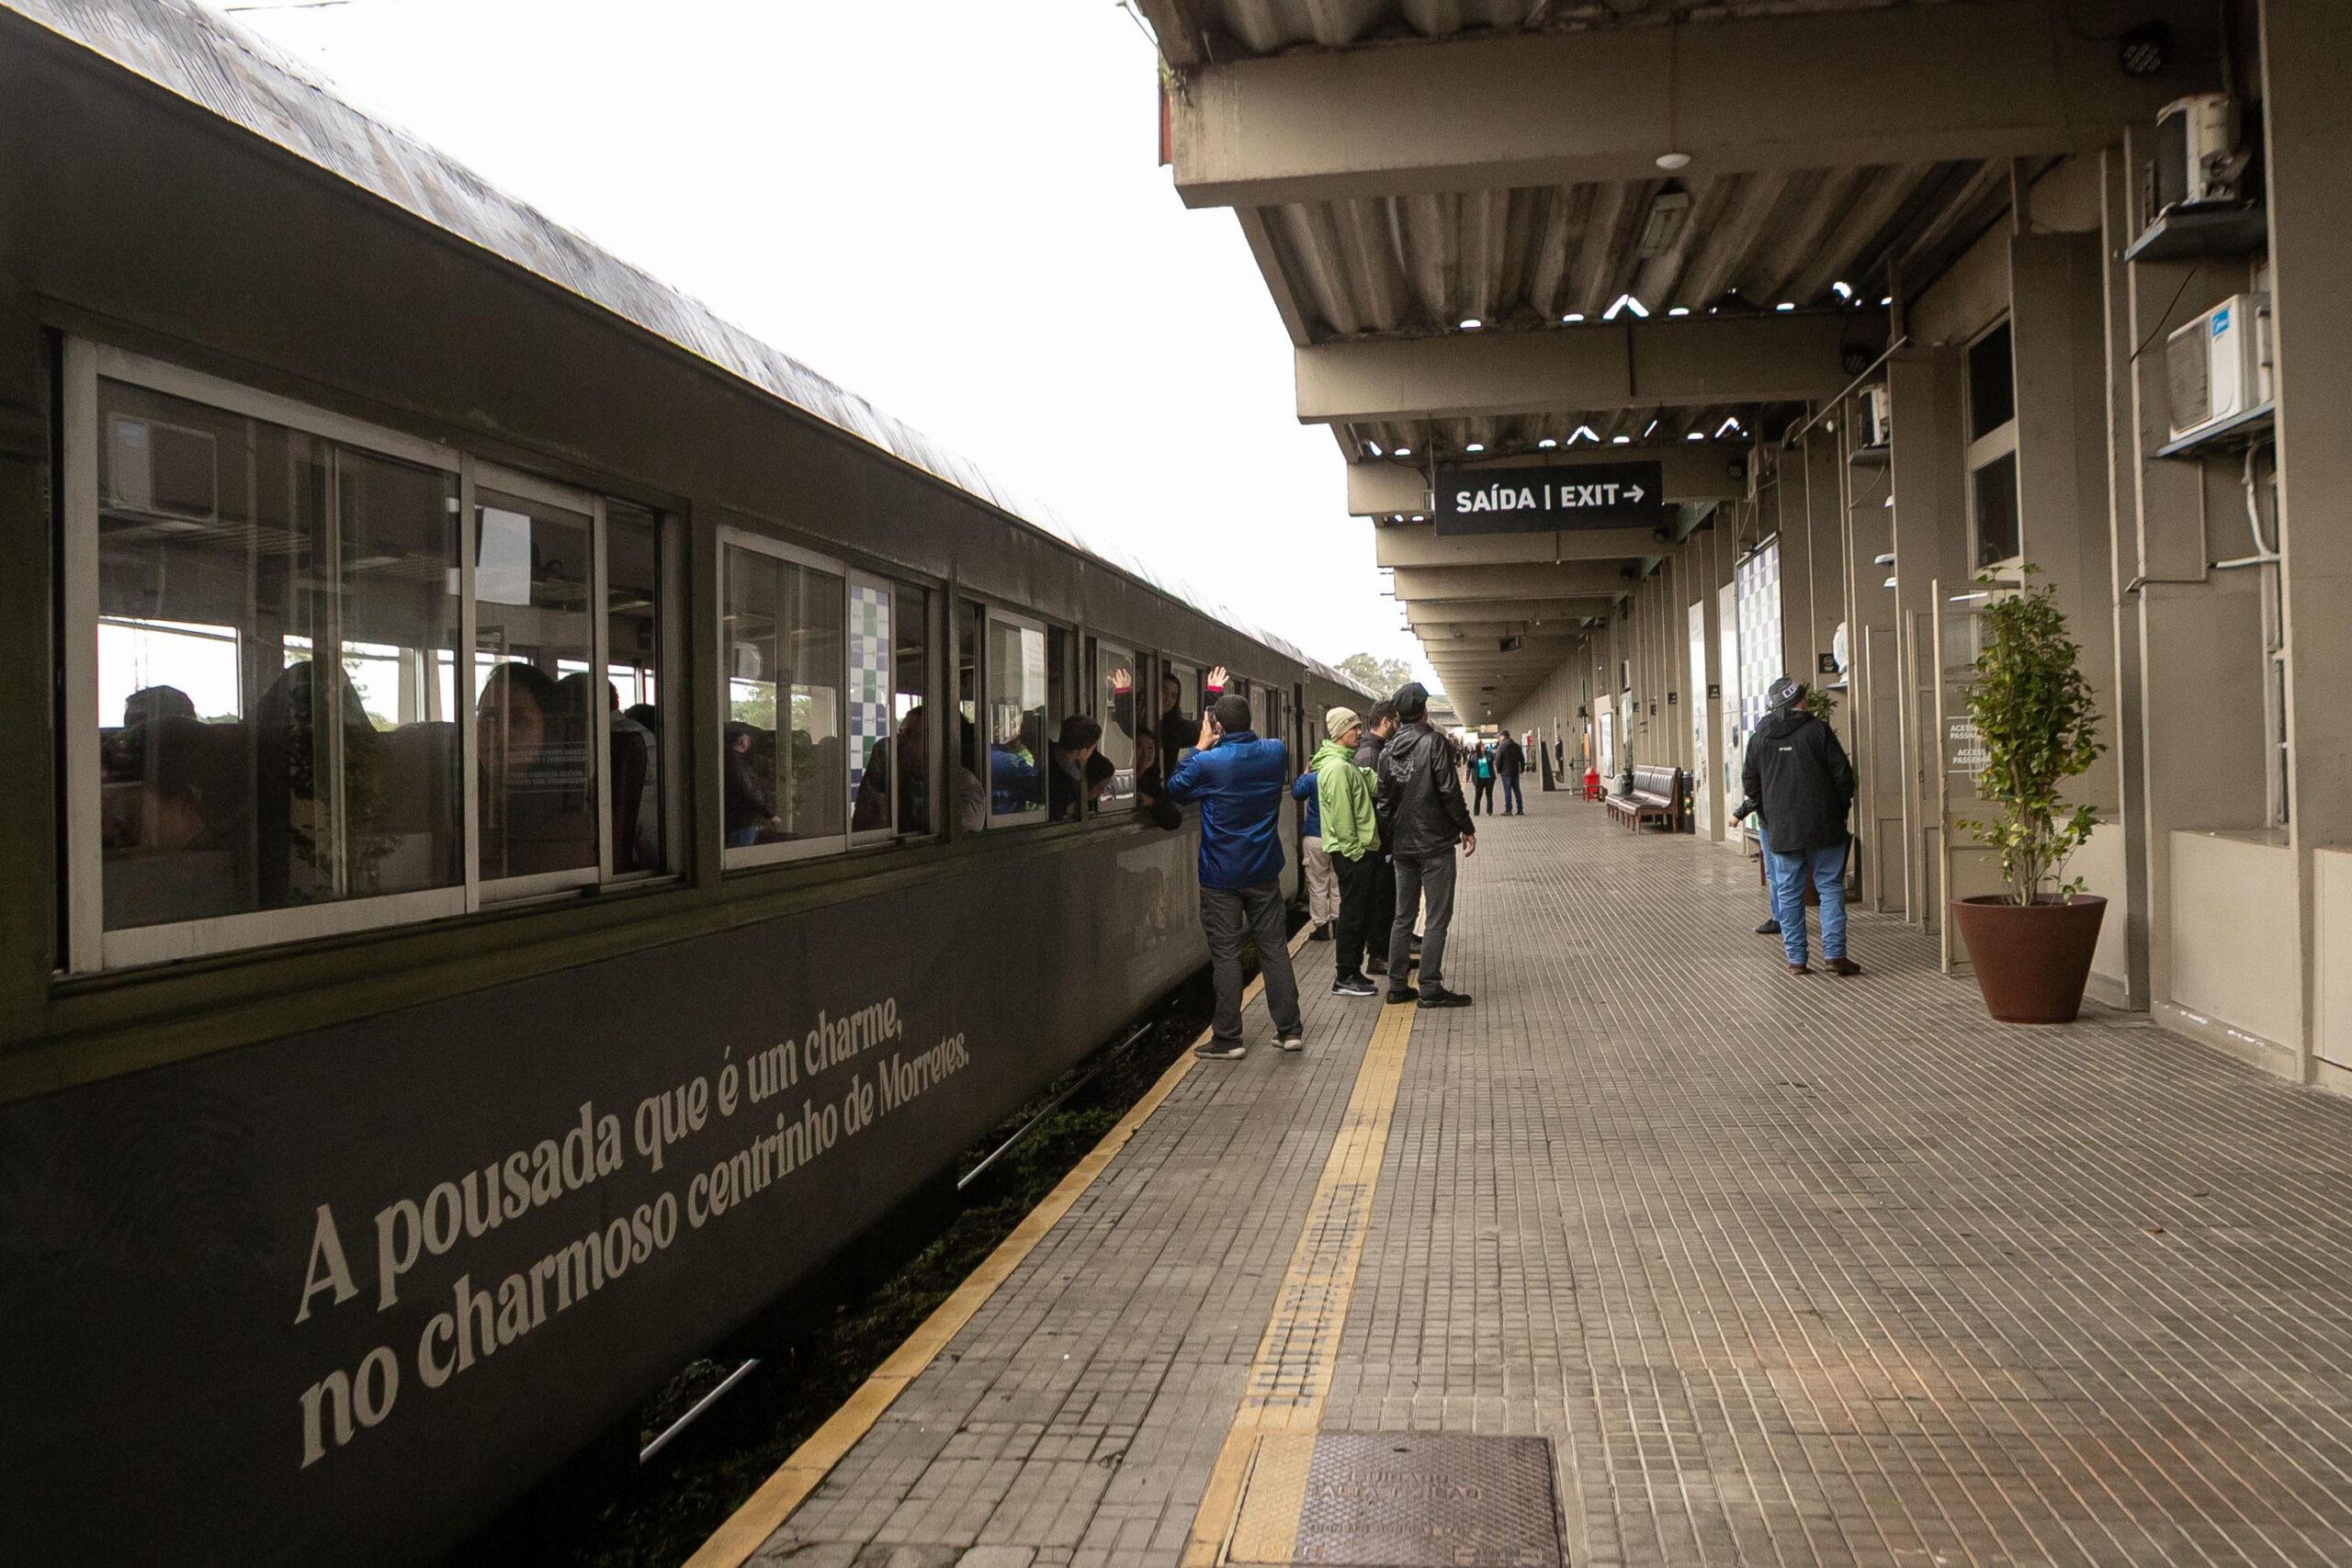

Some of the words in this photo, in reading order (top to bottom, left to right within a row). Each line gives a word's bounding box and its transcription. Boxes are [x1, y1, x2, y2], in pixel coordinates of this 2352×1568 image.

[1455, 483, 1536, 513] SAÍDA
[1561, 483, 1621, 508] EXIT
[294, 1203, 359, 1325] A
[374, 1100, 624, 1312] pousada
[634, 1076, 708, 1173] que
[718, 1044, 739, 1117] é
[747, 1039, 798, 1104] um
[804, 997, 903, 1076] charme,
[300, 1347, 399, 1469] no
[418, 1191, 678, 1388] charmoso
[687, 1099, 838, 1229] centrinho
[843, 1074, 874, 1135] de
[878, 1032, 969, 1116] Morretes.
